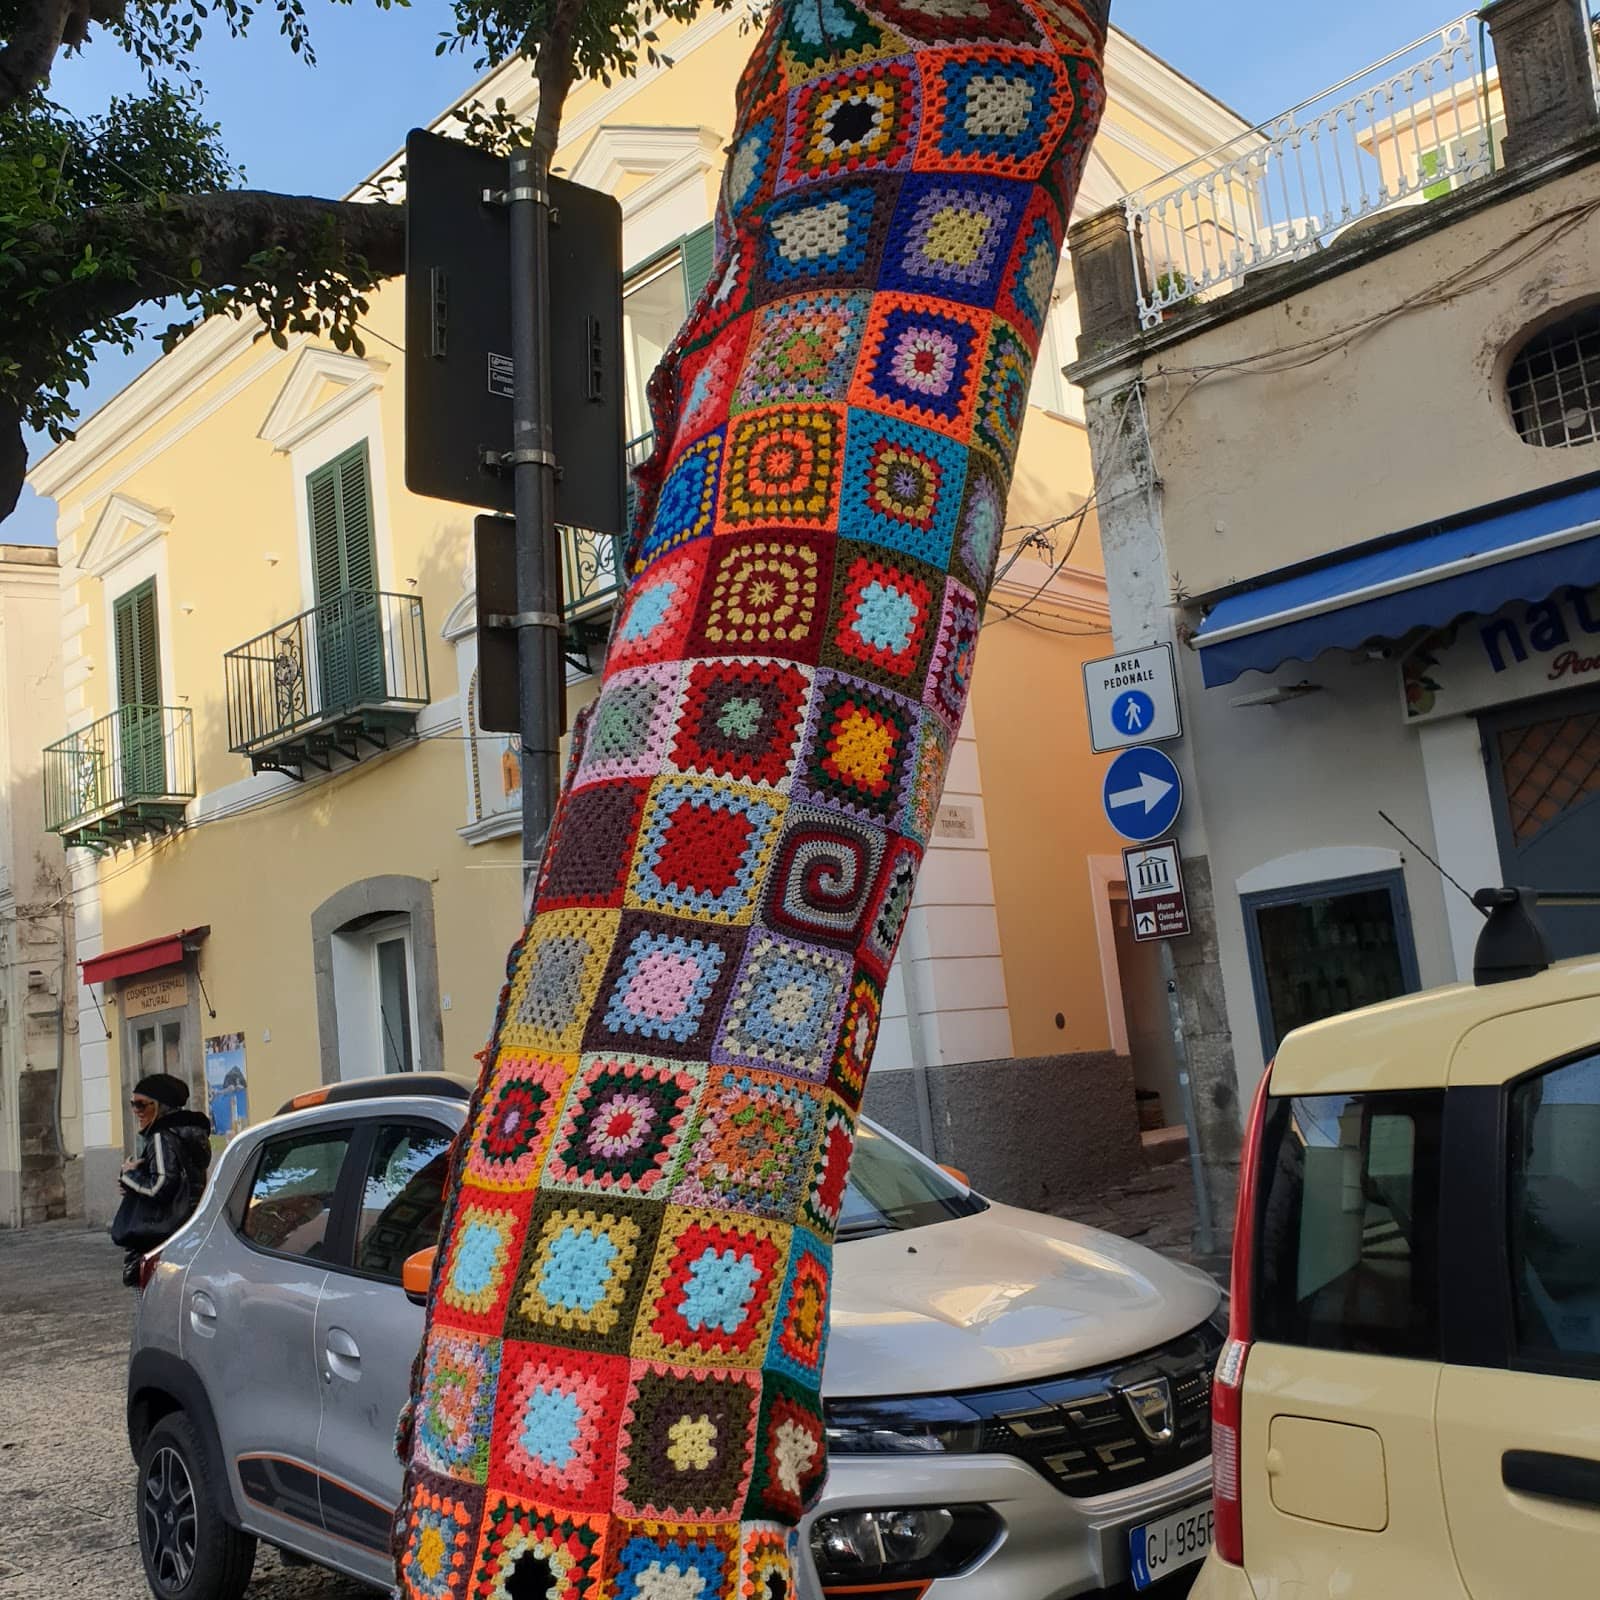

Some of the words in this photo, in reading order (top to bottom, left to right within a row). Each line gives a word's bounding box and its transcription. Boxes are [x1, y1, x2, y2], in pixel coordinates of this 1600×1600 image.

[1114, 659, 1141, 674] AREA
[1104, 670, 1155, 690] PEDONALE
[1157, 902, 1176, 911] Museo
[1159, 912, 1175, 921] Civico
[1175, 909, 1185, 919] del
[1160, 922, 1183, 932] Torrione
[126, 984, 158, 1001] COSMETICI
[158, 977, 185, 992] TERMALI
[142, 993, 170, 1009] NATURALI
